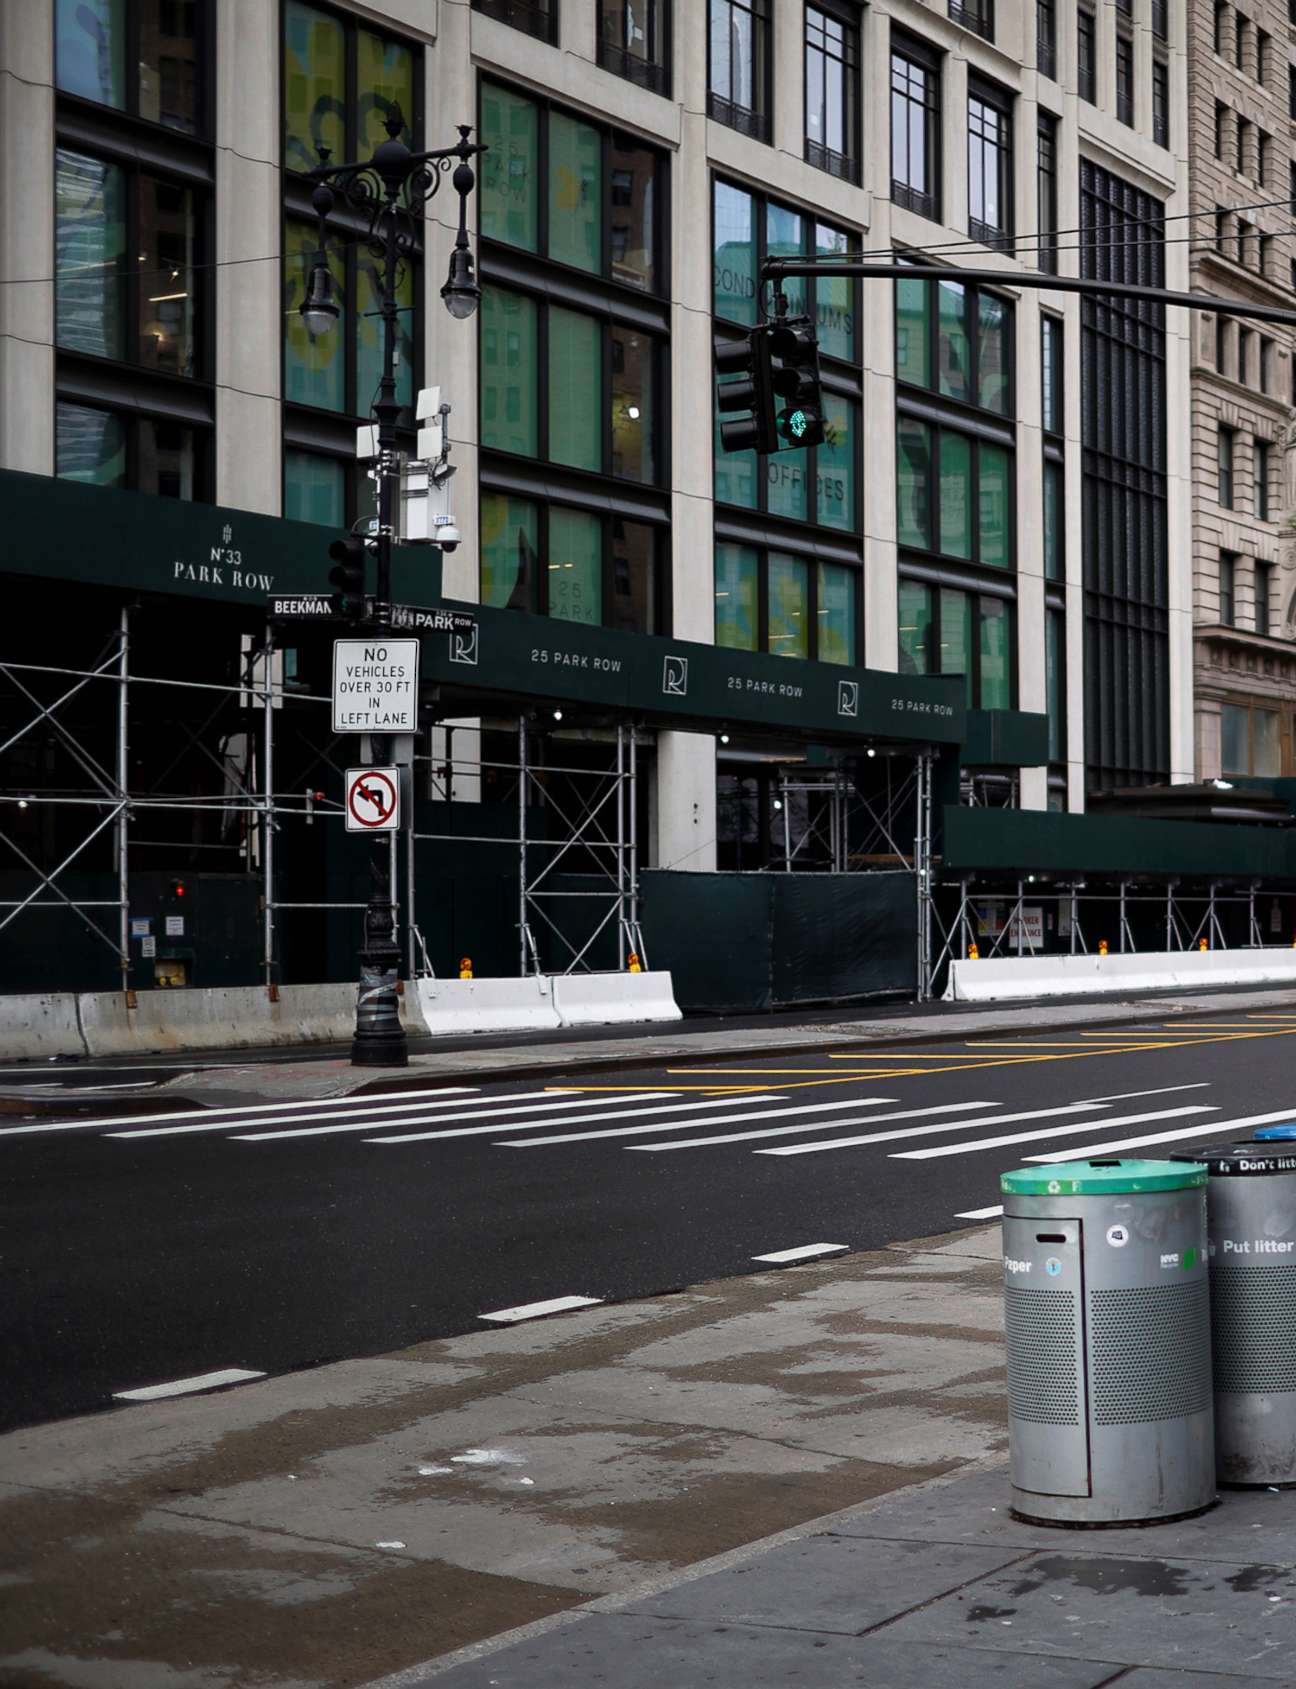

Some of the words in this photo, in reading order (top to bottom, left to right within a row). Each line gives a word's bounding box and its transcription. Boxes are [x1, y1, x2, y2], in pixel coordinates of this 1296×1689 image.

[174, 561, 223, 585] PARK
[232, 570, 275, 591] ROW
[416, 613, 454, 631] PARK
[454, 617, 472, 627] ROW
[364, 647, 388, 662] NO
[531, 649, 549, 664] 25
[554, 651, 589, 669] PARK
[593, 657, 622, 672] ROW
[345, 666, 405, 678] VEHICLES
[339, 681, 371, 693] OVER
[376, 681, 393, 693] 30
[396, 681, 411, 693] FT
[727, 676, 742, 690] 25
[746, 679, 776, 694] PARK
[778, 683, 803, 698] ROW
[368, 697, 381, 709] IN
[891, 699, 904, 711] 25
[907, 701, 931, 714] PARK
[934, 704, 954, 717] ROW
[341, 712, 370, 725] LEFT
[374, 712, 408, 725] LANE
[1239, 1158, 1275, 1171] Don't
[1223, 1240, 1250, 1253] Put
[1254, 1239, 1294, 1253] litter
